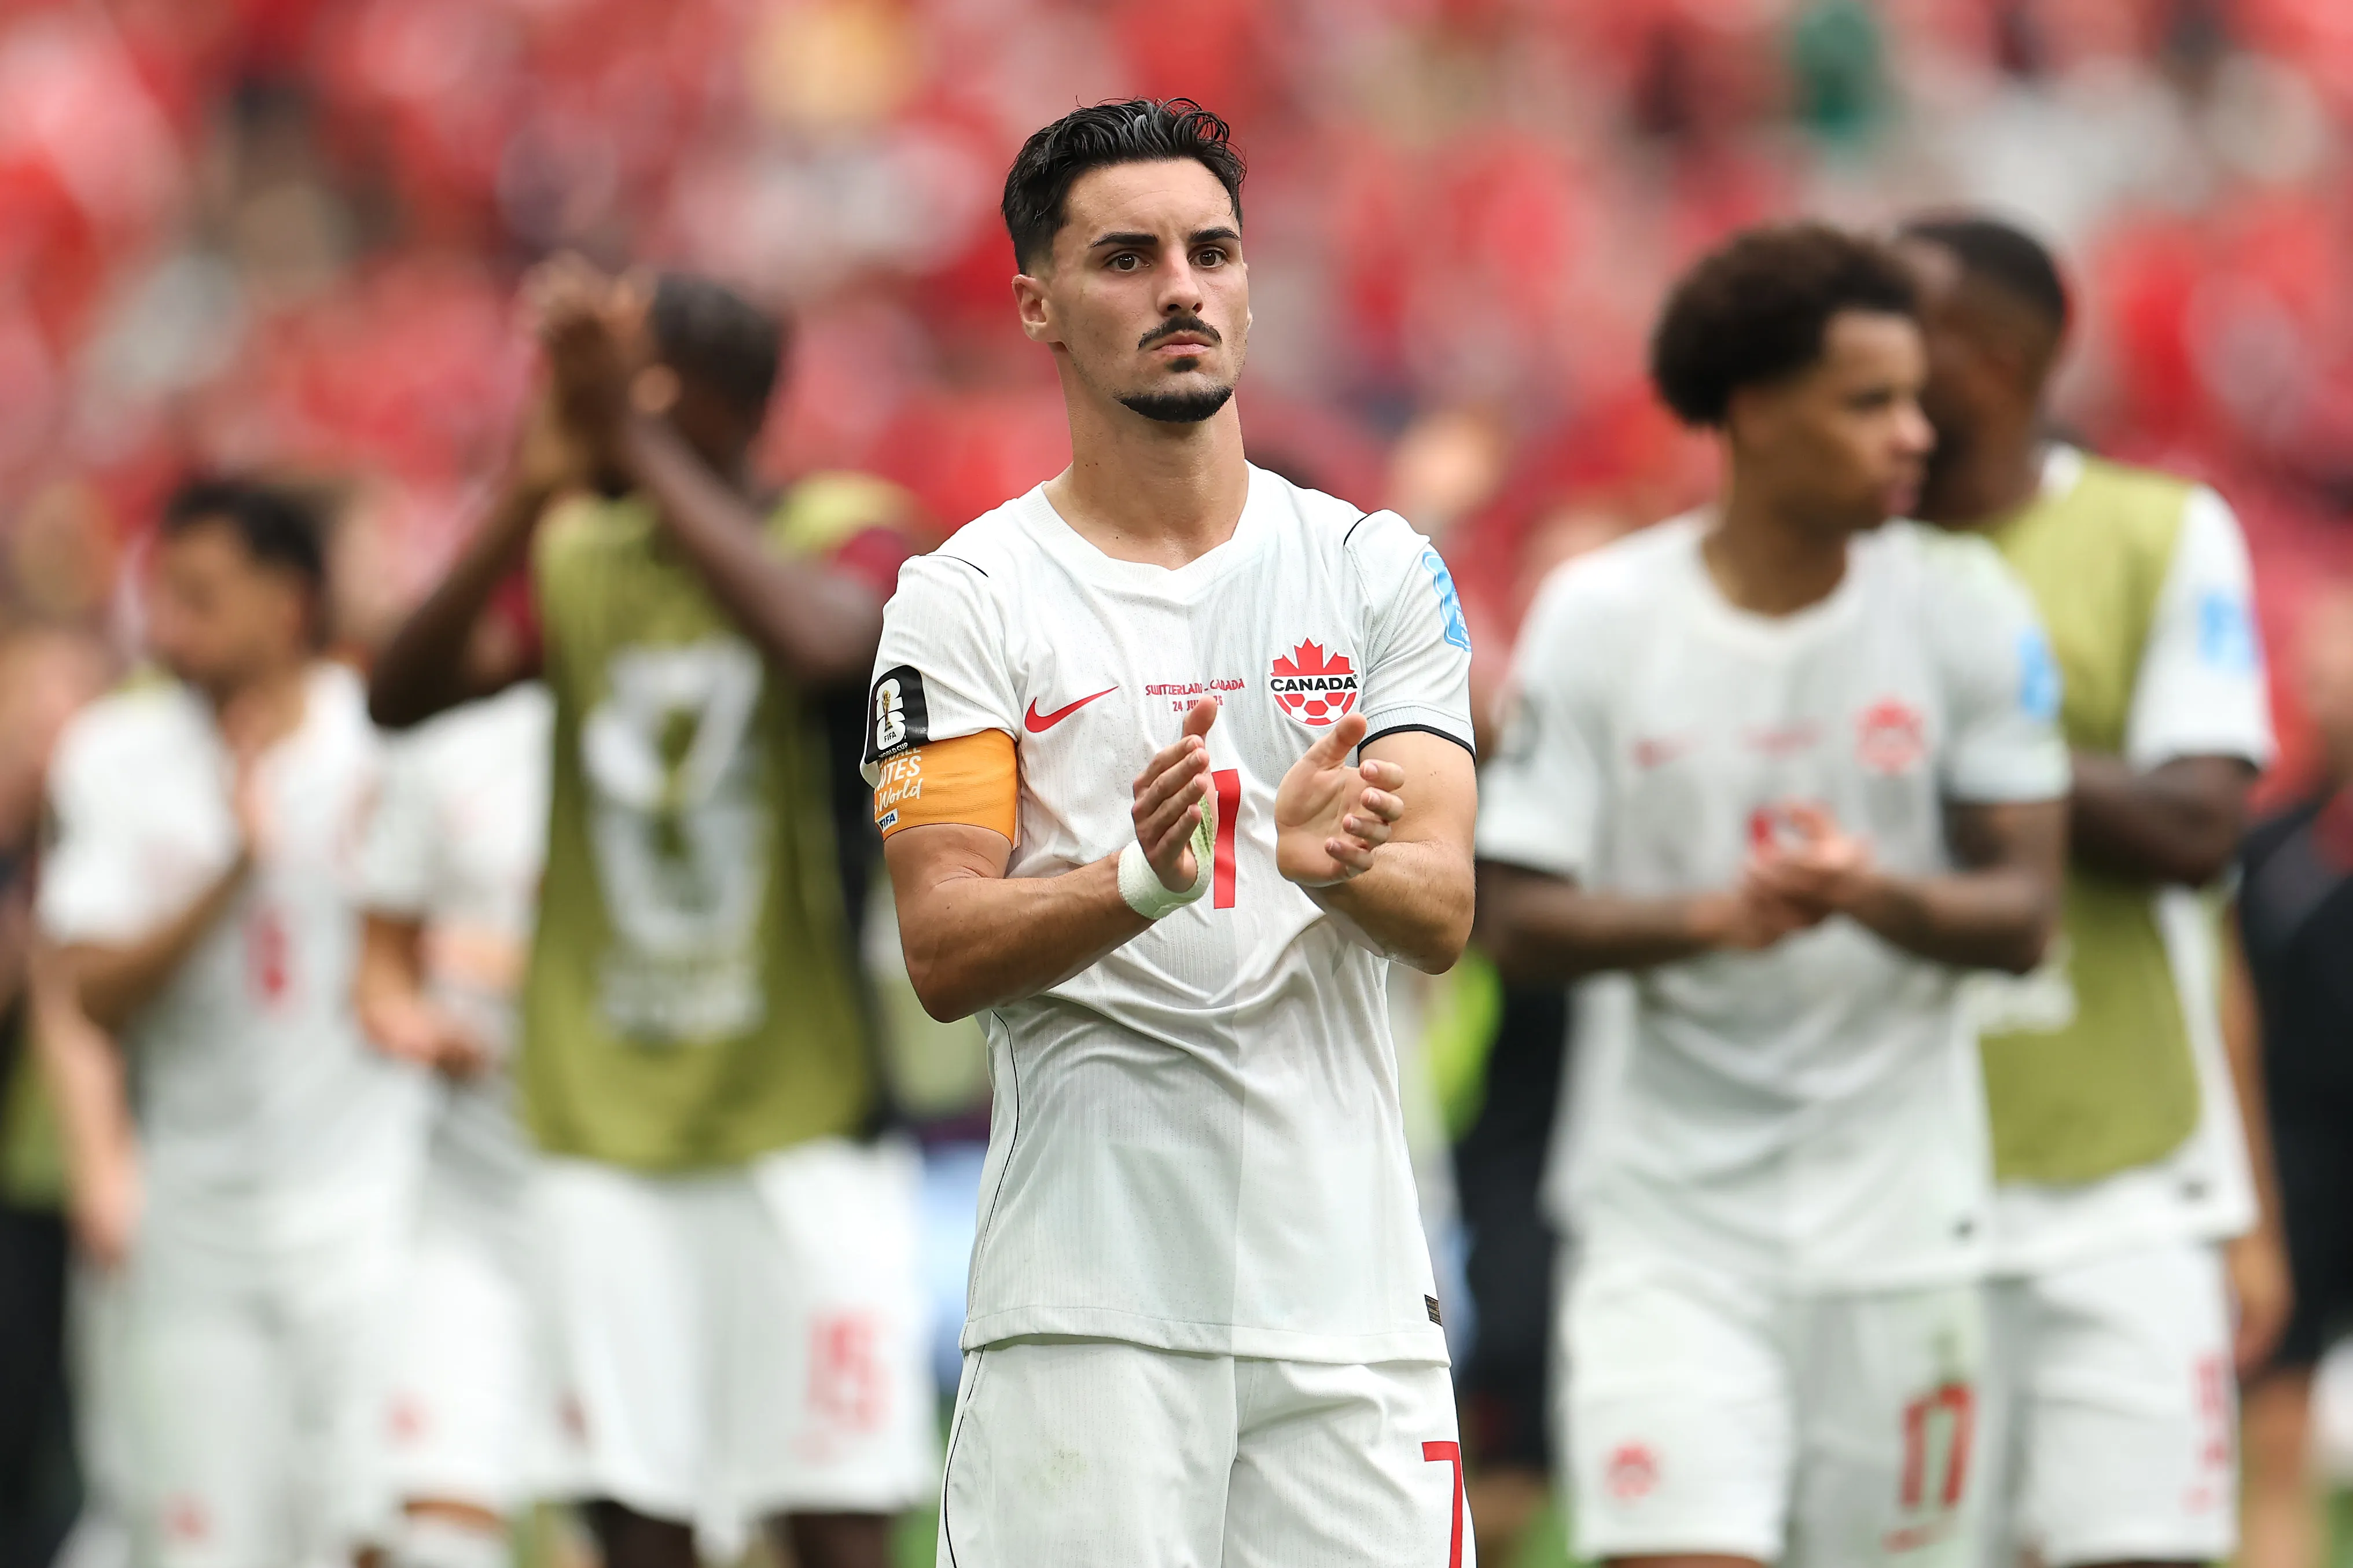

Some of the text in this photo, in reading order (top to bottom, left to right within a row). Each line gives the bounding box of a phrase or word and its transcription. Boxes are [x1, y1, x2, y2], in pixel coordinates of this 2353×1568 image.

[1210, 678, 1245, 691] CANADA
[1270, 676, 1358, 691] CANADA
[1172, 701, 1183, 712] 24
[1186, 699, 1200, 711] JU
[884, 731, 896, 743] FIFA
[896, 742, 908, 751] CUP
[879, 778, 924, 812] World
[879, 812, 896, 830] FIFA
[1421, 1441, 1463, 1568] 7
